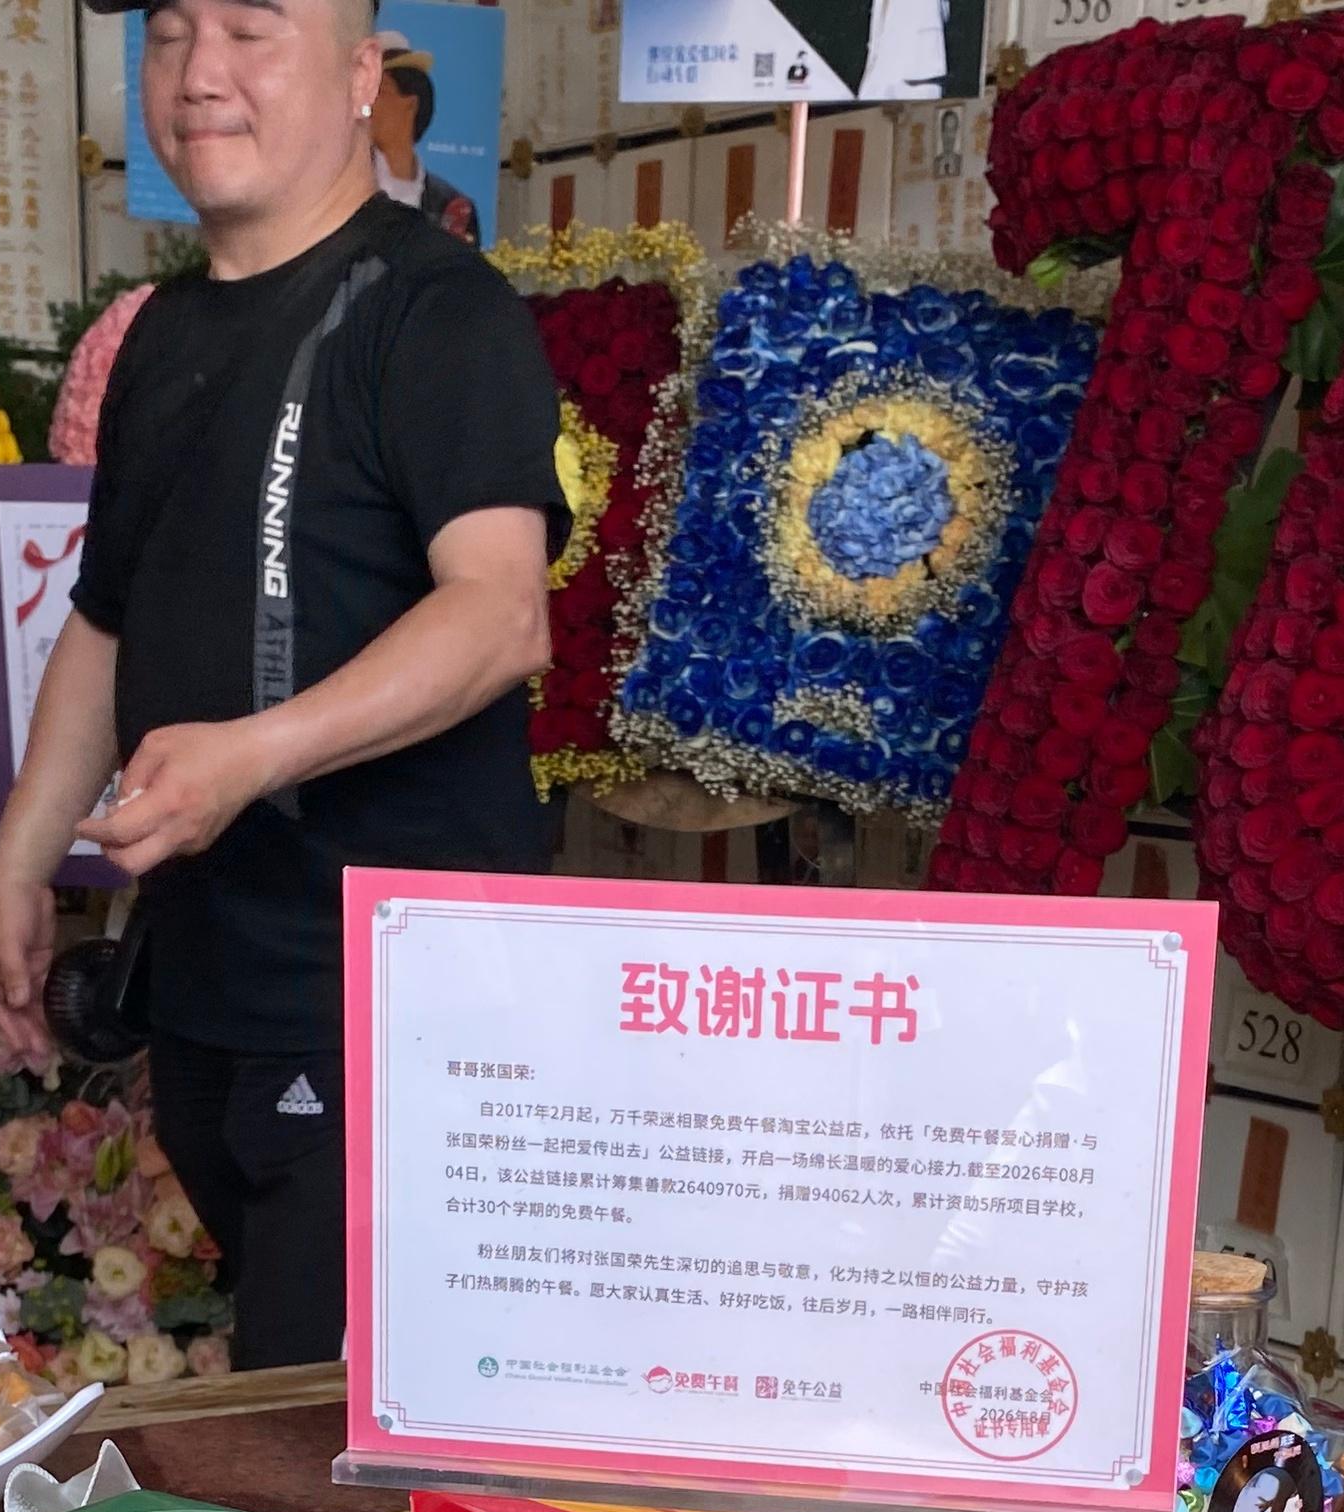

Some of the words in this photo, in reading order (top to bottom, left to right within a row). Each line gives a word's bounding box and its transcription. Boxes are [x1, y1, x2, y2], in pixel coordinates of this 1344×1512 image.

[262, 402, 303, 599] RUNNING
[619, 962, 920, 1045] 致谢证书
[1238, 1011, 1303, 1065] 528
[446, 1060, 536, 1081] 哥哥张国荣:
[445, 1197, 635, 1225] 合计30个学期的免费午餐。
[782, 1379, 843, 1399] 免午公益
[919, 1380, 1054, 1403] 中国社会福利基金会
